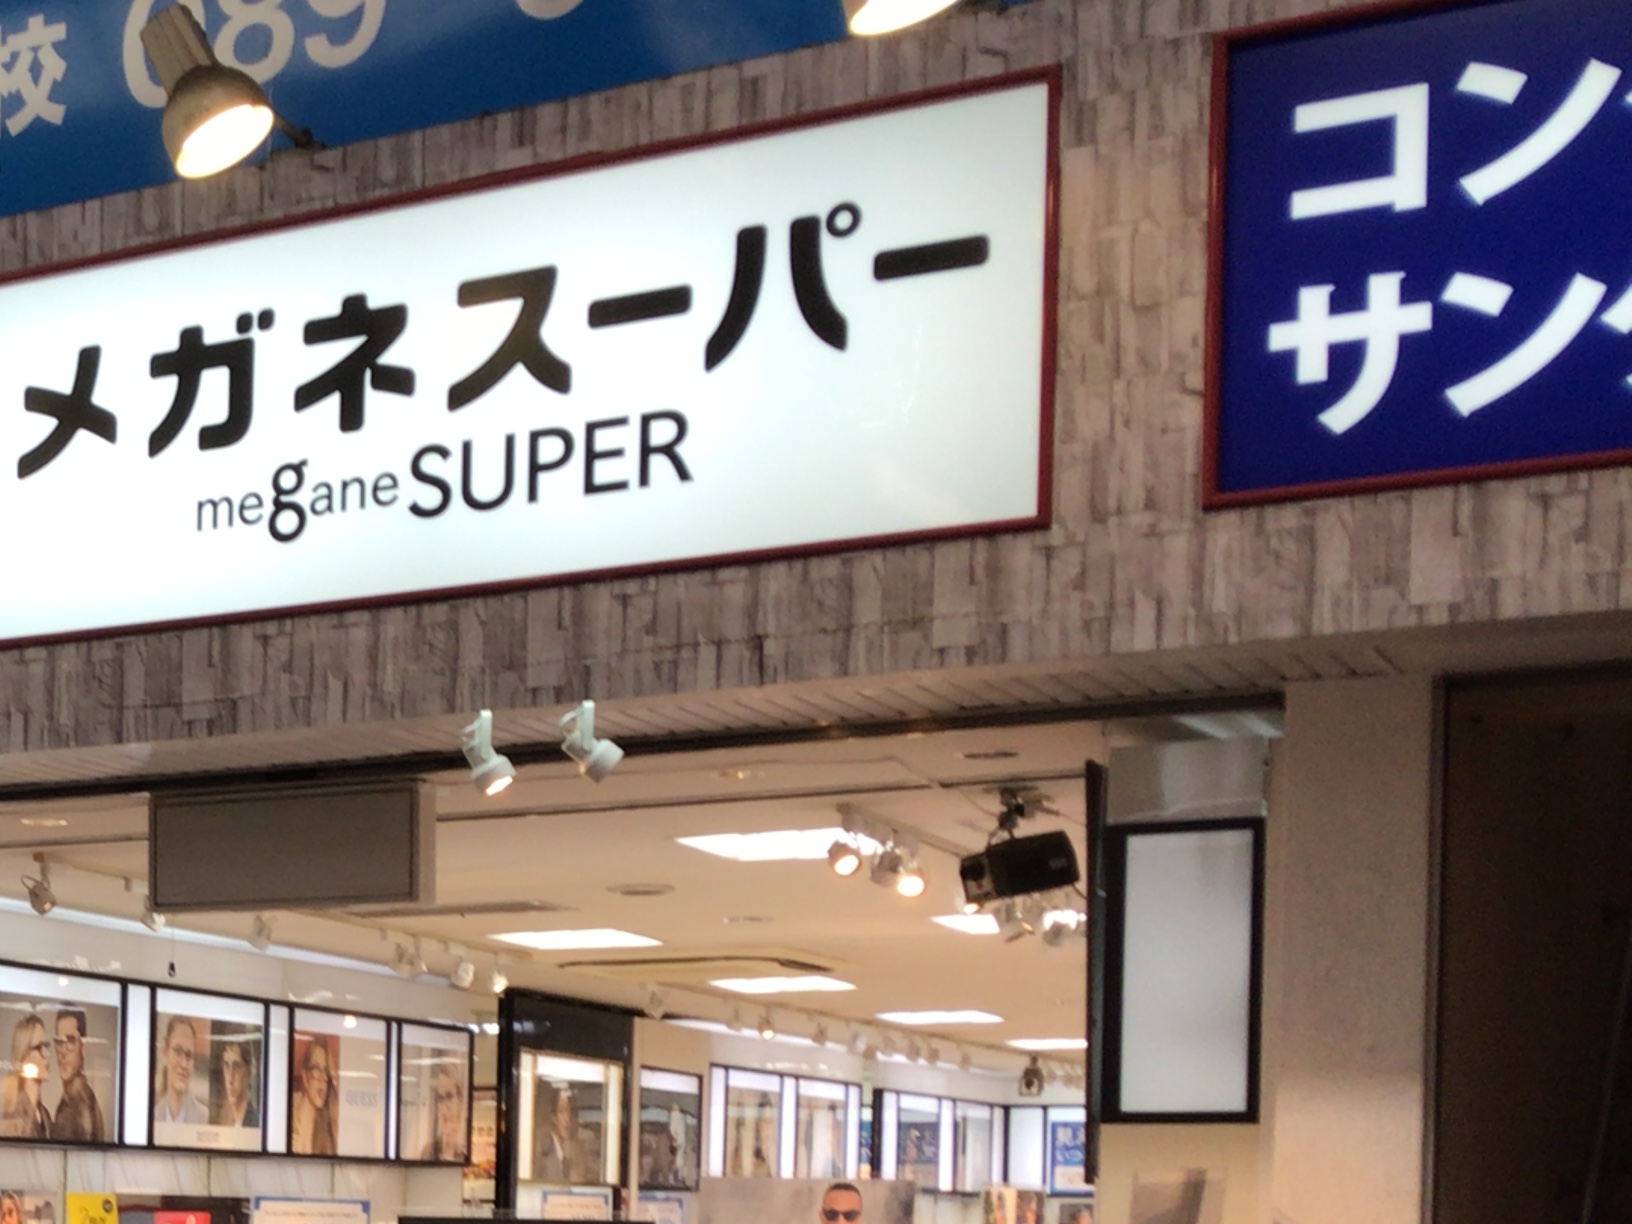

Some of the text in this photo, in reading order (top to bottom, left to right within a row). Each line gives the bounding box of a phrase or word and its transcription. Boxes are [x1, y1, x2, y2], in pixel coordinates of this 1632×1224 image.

[1290, 57, 1632, 220] コン
[17, 201, 990, 479] メガネスーパー
[1268, 268, 1632, 435] サン
[195, 410, 695, 543] meganeSUPER
